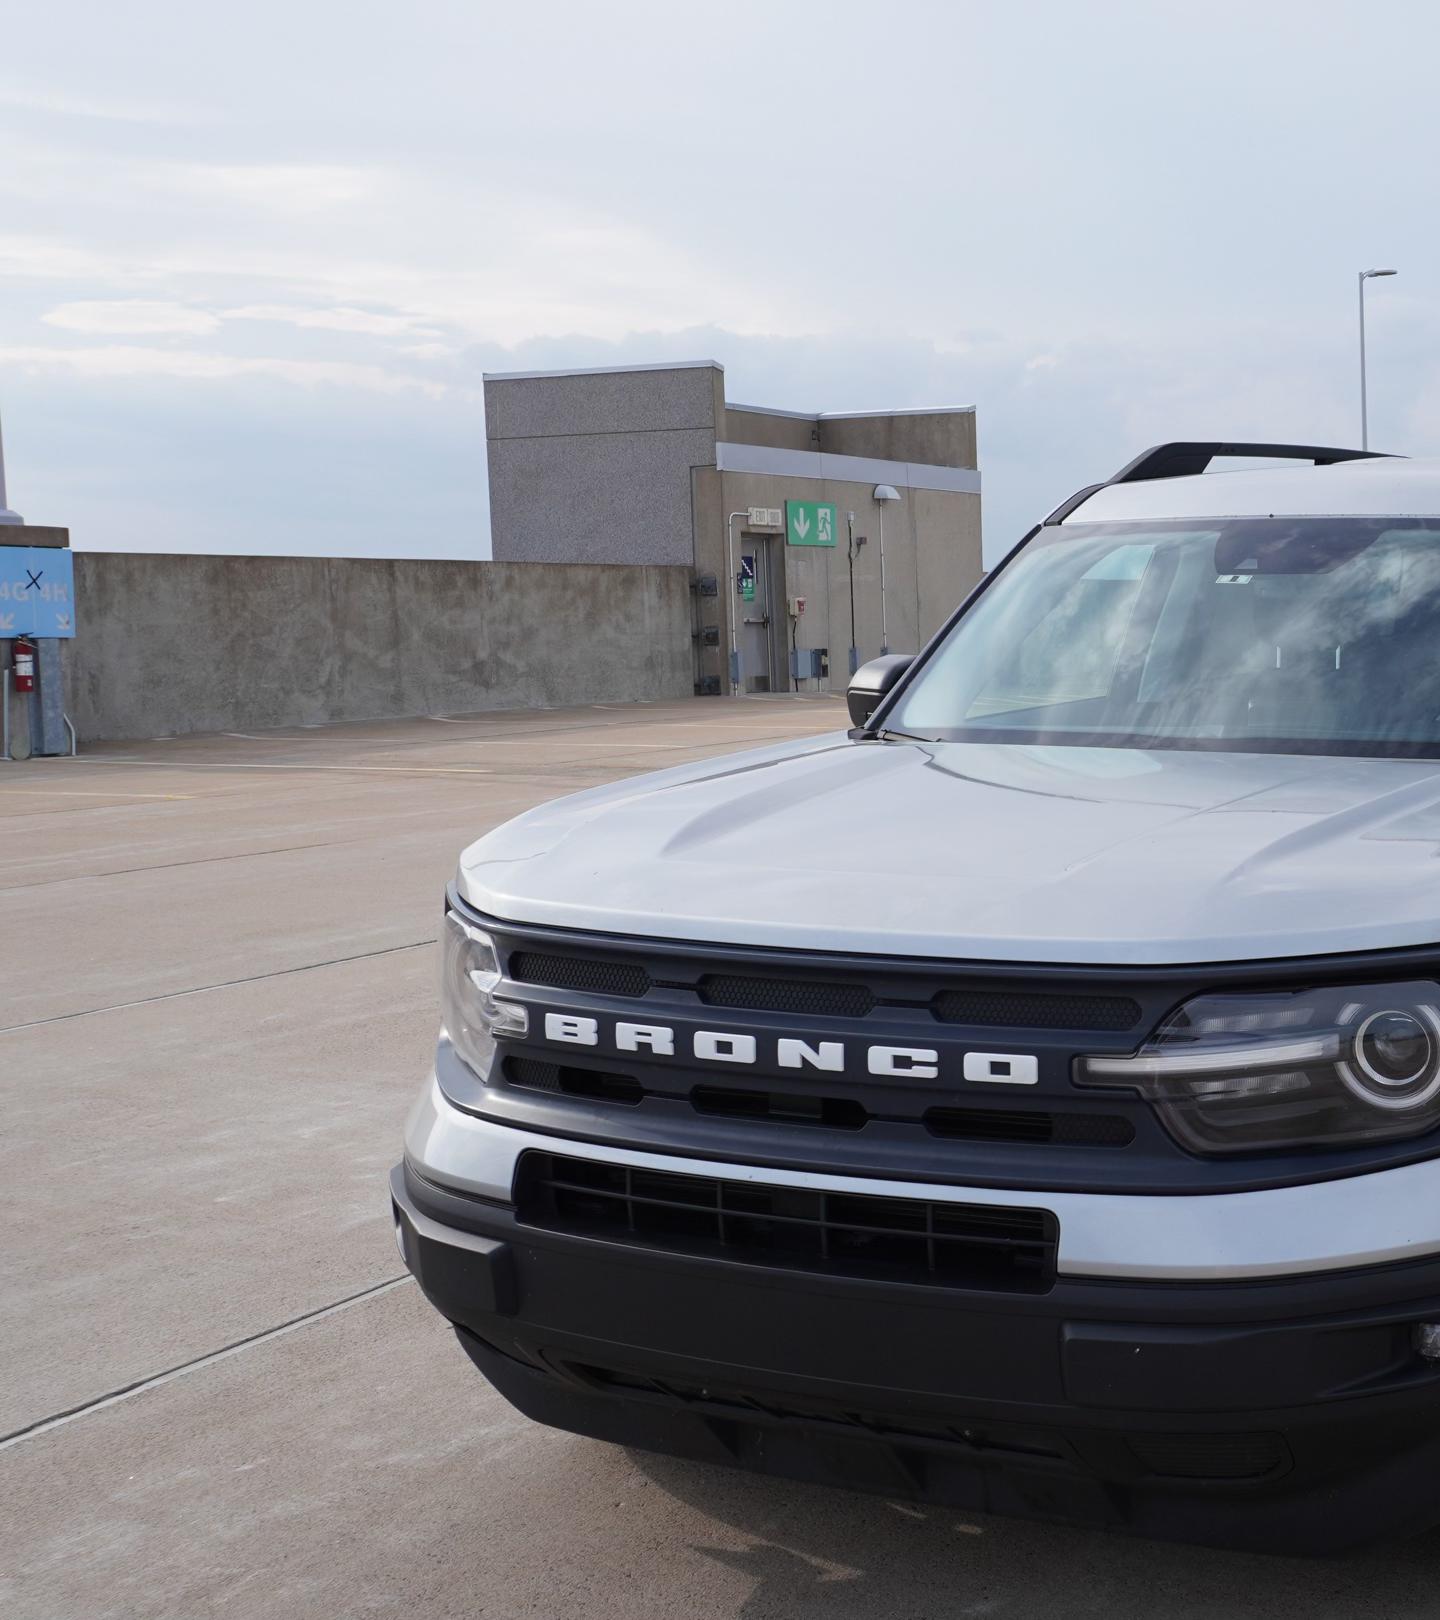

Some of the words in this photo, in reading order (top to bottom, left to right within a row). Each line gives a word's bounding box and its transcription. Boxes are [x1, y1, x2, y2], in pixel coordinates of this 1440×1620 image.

[0, 581, 29, 601] 4G
[40, 582, 68, 602] 4H
[544, 1012, 1039, 1086] BRONCO
